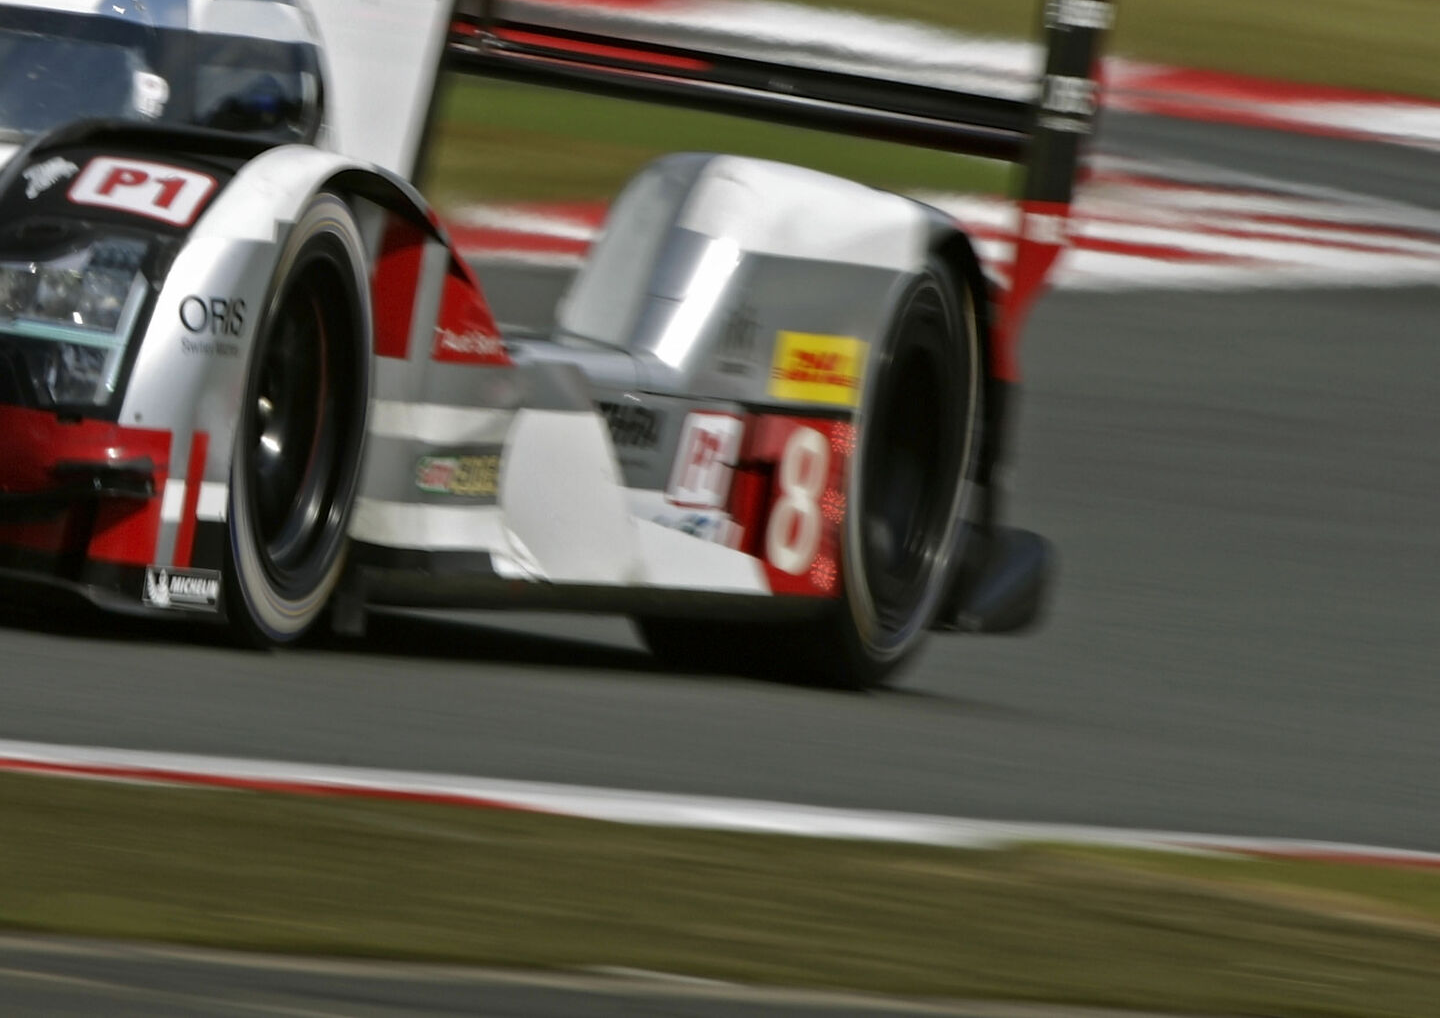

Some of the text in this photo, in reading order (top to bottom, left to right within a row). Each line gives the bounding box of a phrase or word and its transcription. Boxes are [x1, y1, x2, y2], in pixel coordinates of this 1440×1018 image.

[95, 166, 188, 211] P1
[179, 294, 248, 338] ORIS
[765, 425, 830, 576] 8
[170, 575, 220, 598] MICHELIN
